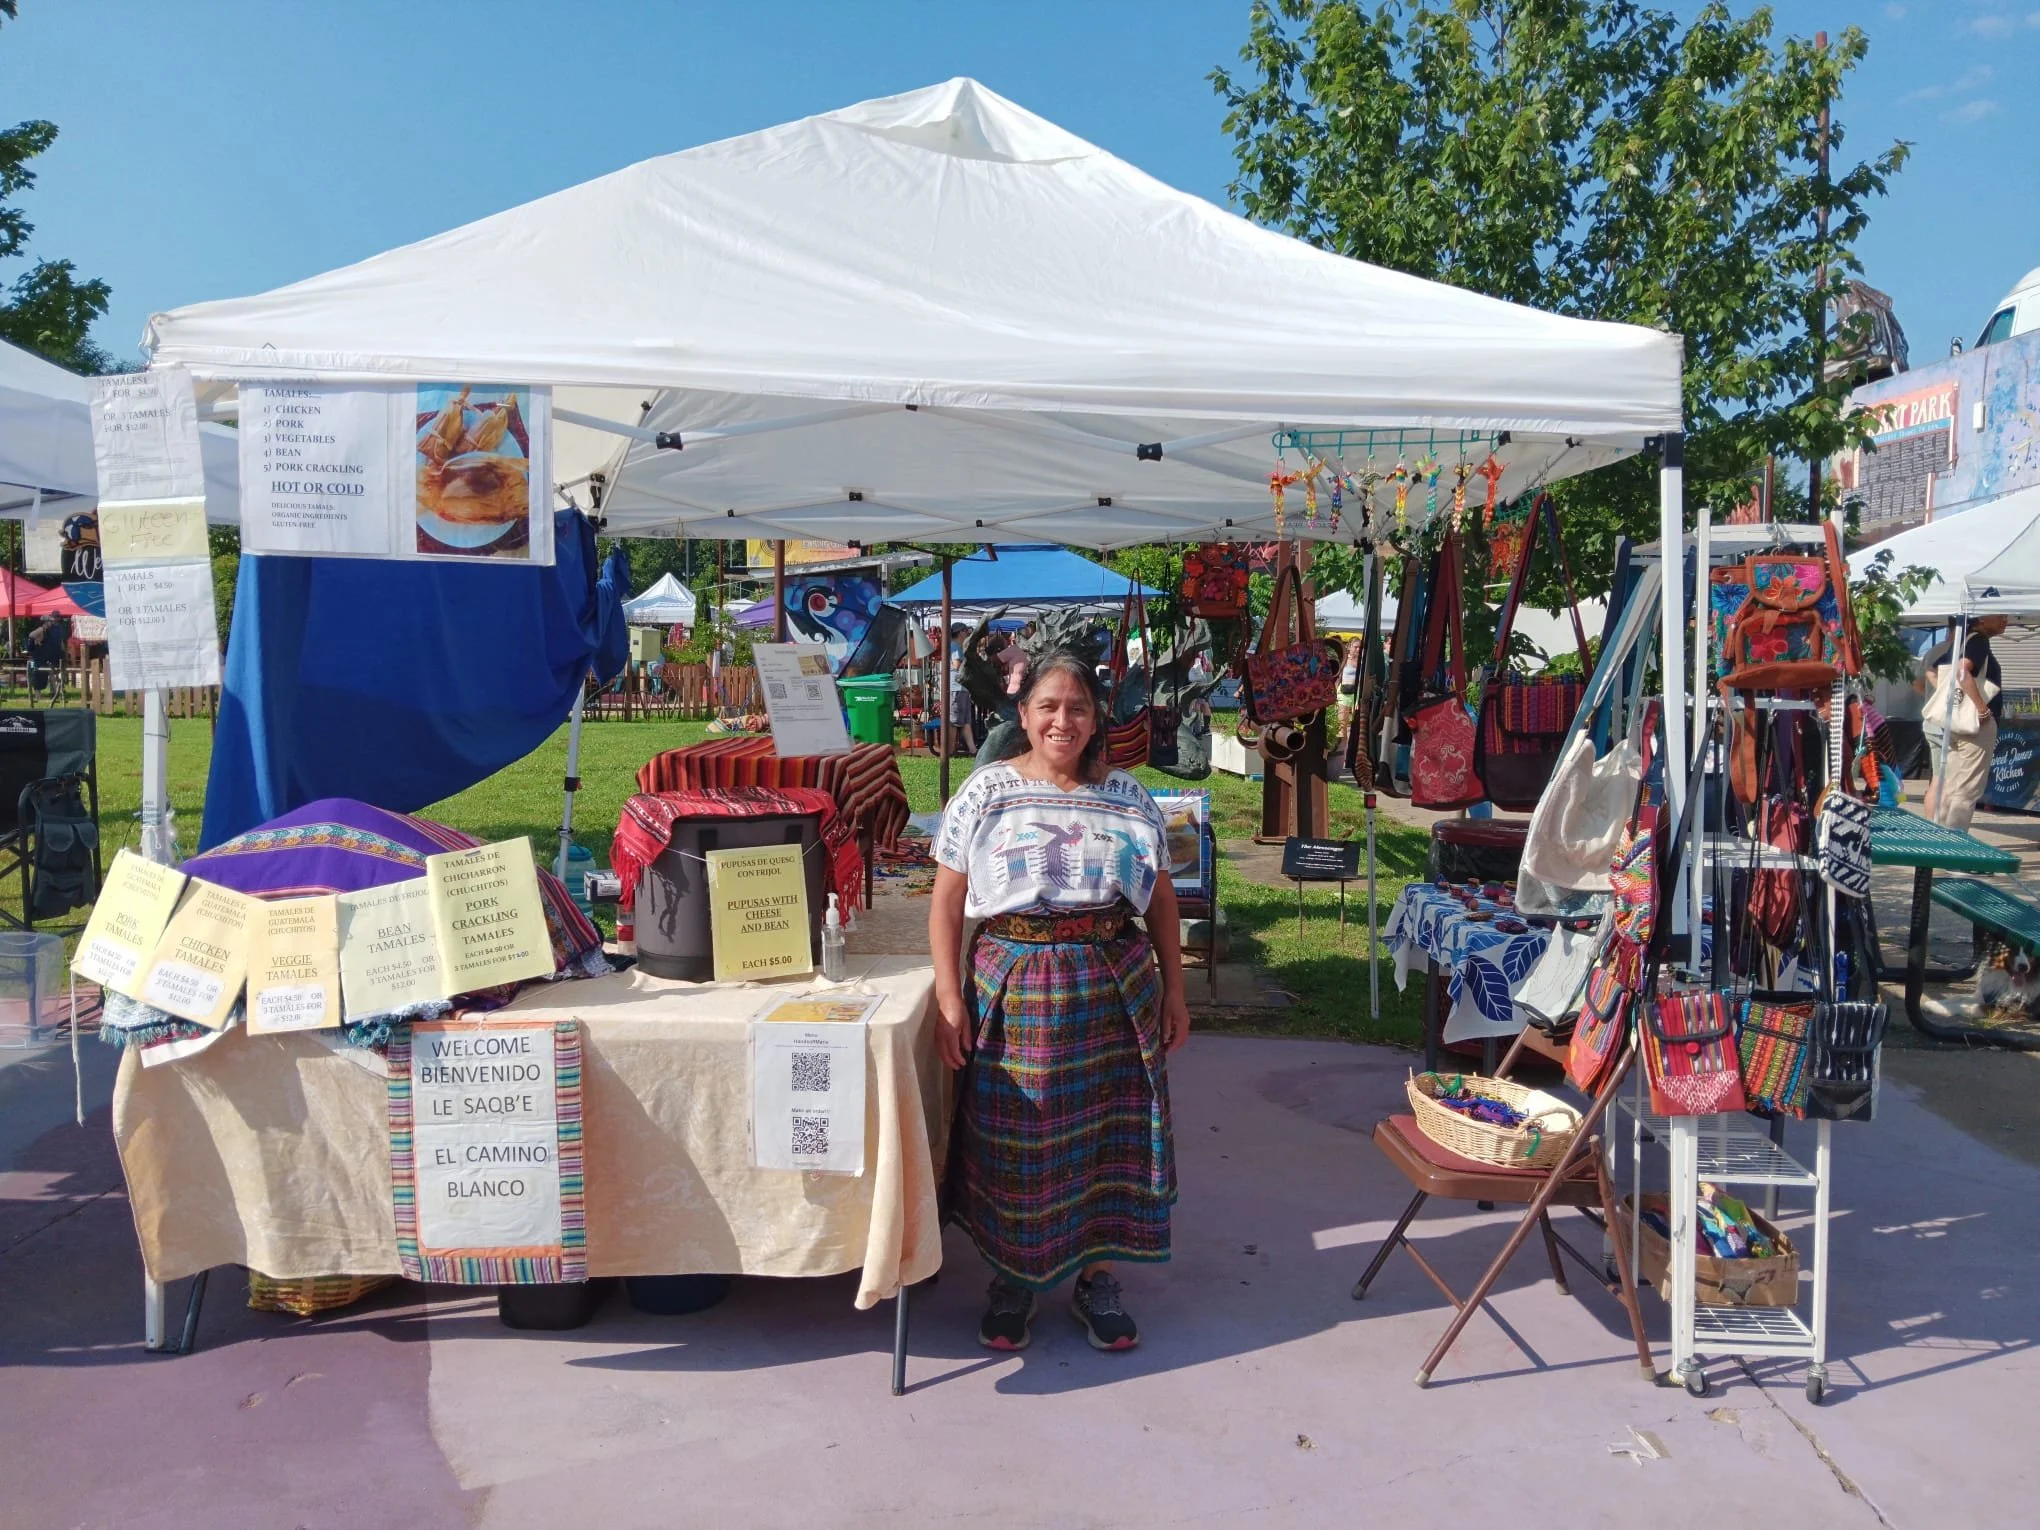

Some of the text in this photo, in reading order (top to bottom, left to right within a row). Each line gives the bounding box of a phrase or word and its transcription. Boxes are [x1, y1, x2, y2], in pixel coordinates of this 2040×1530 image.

[113, 388, 131, 398] FOR
[103, 412, 117, 421] OR
[128, 409, 173, 420] TAMALES
[275, 406, 321, 415] CHICKEN
[1909, 392, 1953, 427] PARK
[105, 423, 124, 433] FOR
[275, 420, 304, 429] PORK
[263, 433, 336, 444] 3) VEGETABLES
[263, 448, 302, 457] 4) BEAN
[263, 463, 364, 475] 5) PORK CRACKLING
[271, 481, 365, 496] HOT OR COLD
[271, 502, 307, 510] DELICIOUS
[302, 512, 348, 521] INGREDIENTS
[271, 521, 316, 529] GLUTEN-FREE
[118, 572, 155, 583] TAMALS
[128, 583, 147, 593] FOR
[118, 605, 133, 616] OR
[143, 602, 188, 614] TAMALES
[119, 617, 137, 627] FOR
[1993, 765, 2025, 783] Kitchen
[443, 851, 501, 869] TAMALES DE
[720, 860, 756, 869] PUPUSAS
[769, 856, 795, 865] QUESO
[131, 863, 157, 880] TAMALES
[443, 864, 507, 883] CHICHARRON
[737, 867, 782, 878] CON FRIJOL
[446, 878, 508, 898] (CHUCHITOS)
[206, 890, 238, 907] TAMALES
[349, 897, 388, 912] TAMALES
[388, 894, 401, 903] DE
[465, 896, 499, 912] PORK
[727, 894, 798, 911] PUPUSAS WITH
[201, 899, 246, 920] GUATEMALA
[268, 906, 315, 917] TAMALES DE
[745, 908, 782, 920] CHEESE
[116, 911, 140, 931] PORK
[268, 915, 316, 927] GUATEMALA
[452, 909, 519, 931] CRACKLING
[740, 920, 790, 934] AND BEAN
[104, 921, 144, 947] TAMALES
[268, 925, 316, 937] (CHUCHITOS)
[377, 922, 412, 939] BEAN
[462, 927, 515, 945] TAMALES
[180, 936, 231, 960] CHICKEN
[367, 933, 426, 955] TAMALES
[465, 949, 485, 959] EACH
[503, 943, 515, 951] OR
[92, 953, 120, 973] TAMALES
[175, 948, 226, 974] TAMALES
[272, 955, 312, 968] VEGGIE
[366, 964, 391, 977] EACH
[422, 955, 436, 964] OR
[459, 959, 493, 972] TAMALES
[493, 955, 508, 965] FOR
[742, 955, 792, 969] EACH $5.00
[158, 968, 180, 981] EACH
[206, 983, 219, 993] OR
[266, 968, 318, 981] TAMALES
[377, 969, 418, 984] TAMALES
[418, 964, 437, 975] FOR
[161, 980, 197, 997] TAMALES
[198, 992, 215, 1002] FOR
[262, 996, 283, 1005] EACH
[311, 992, 322, 1000] OR
[270, 1005, 305, 1014] TAMALES
[306, 1002, 322, 1010] FOR
[432, 1036, 531, 1058] WELCOME
[421, 1064, 541, 1084] BIENVENIDO
[433, 1099, 453, 1116] LE
[435, 1145, 548, 1165] EL CAMINO
[447, 1179, 525, 1198] BLANCO
